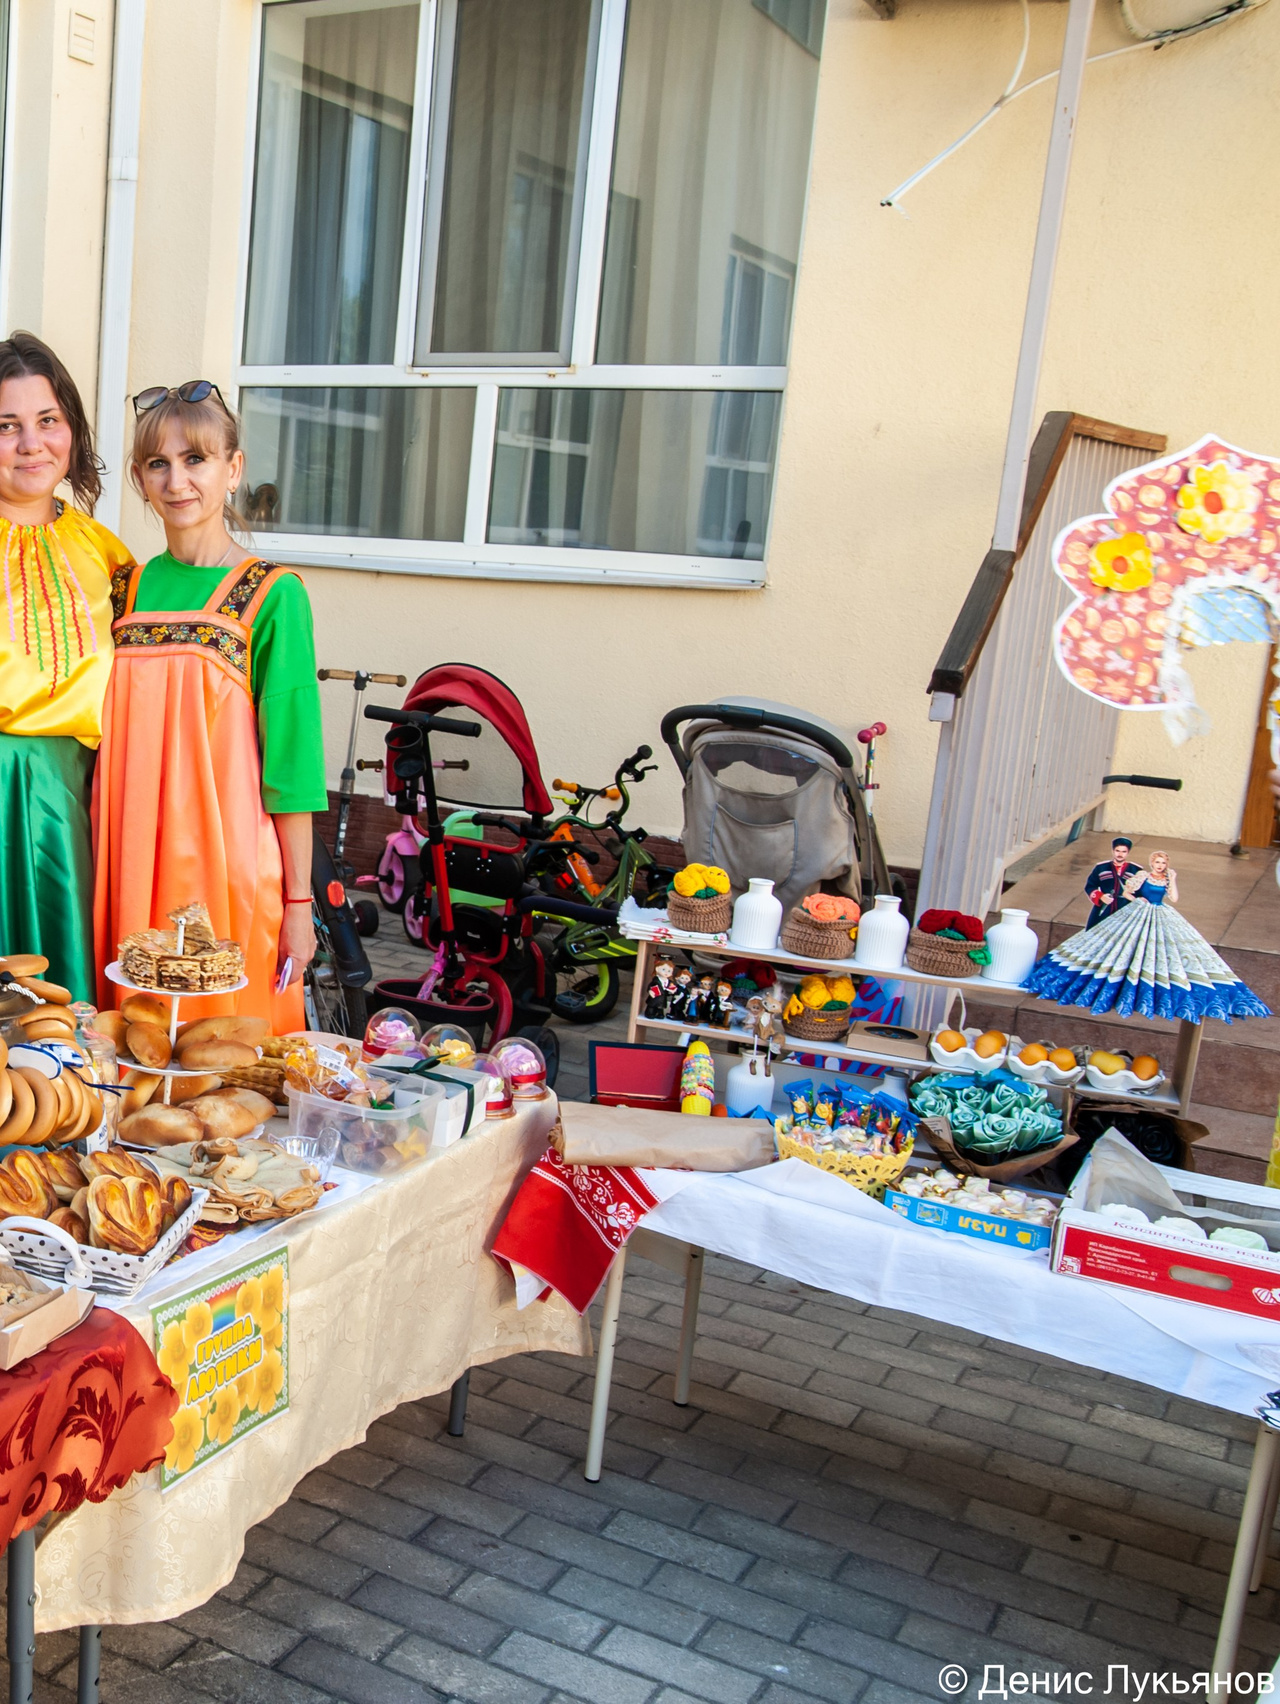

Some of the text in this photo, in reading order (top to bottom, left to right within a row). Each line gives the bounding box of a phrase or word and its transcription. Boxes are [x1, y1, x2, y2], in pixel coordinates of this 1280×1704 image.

[958, 1215, 1007, 1238] ПАЗЛ
[196, 1315, 253, 1366] ГРУППА
[187, 1338, 263, 1405] ЛЮТИКИ
